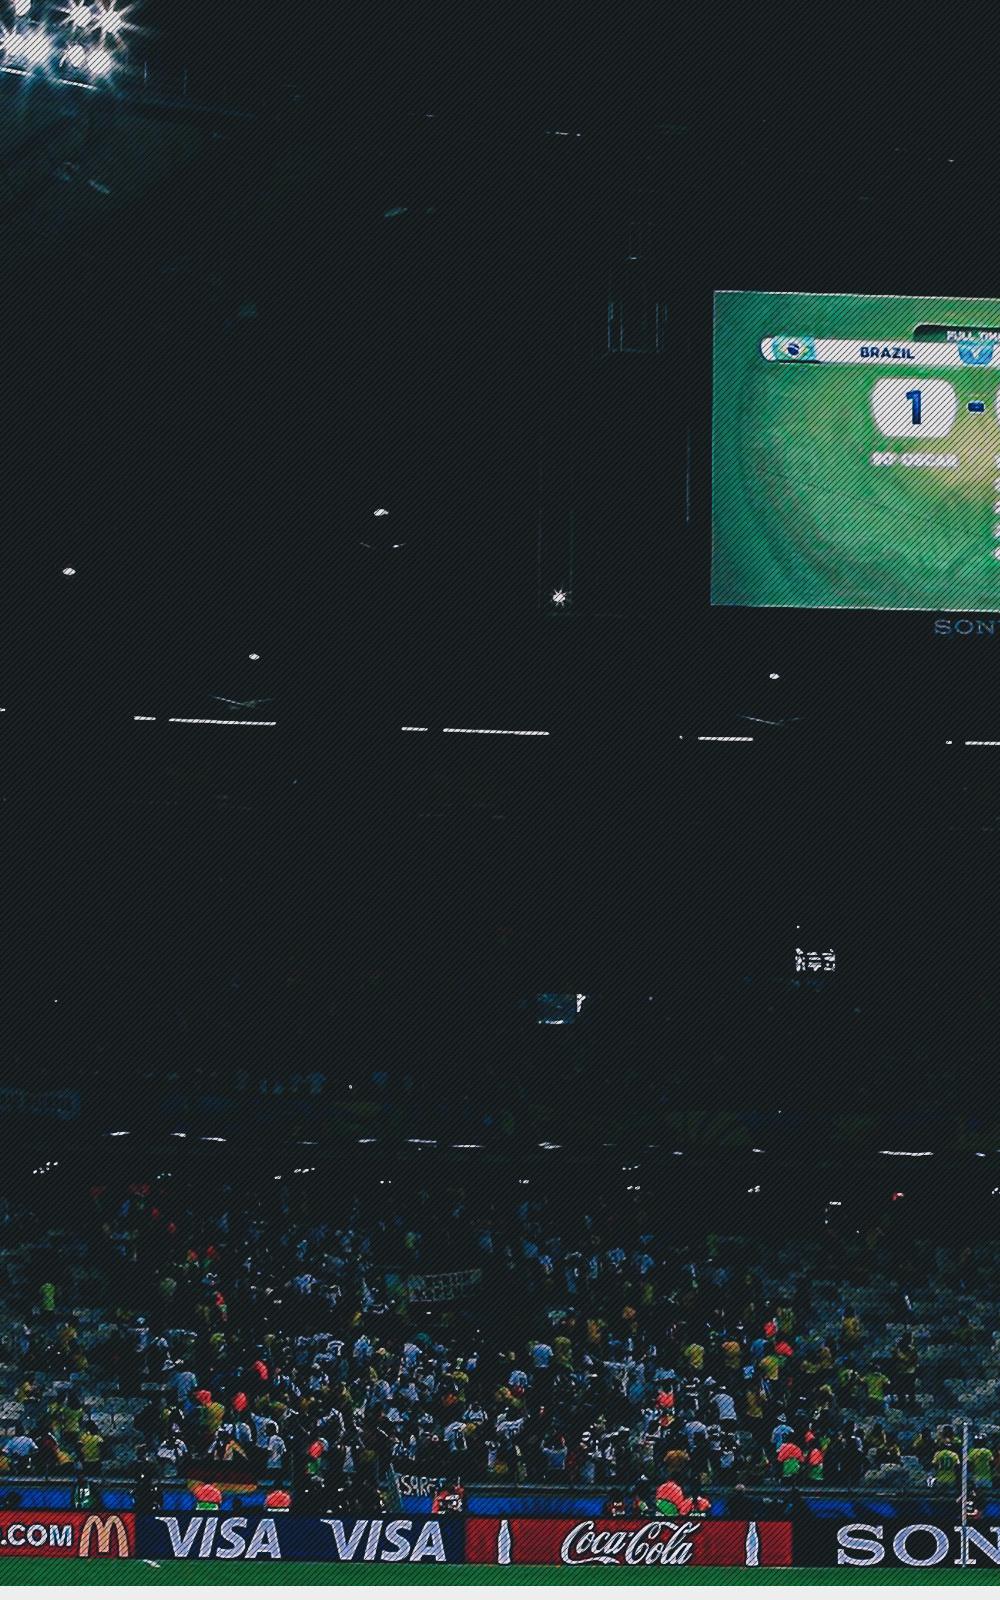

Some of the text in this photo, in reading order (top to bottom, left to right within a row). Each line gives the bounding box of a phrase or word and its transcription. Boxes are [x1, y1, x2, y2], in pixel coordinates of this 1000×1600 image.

[946, 330, 974, 342] FULL
[860, 346, 916, 360] BRAZIL
[905, 390, 922, 425] 1
[901, 453, 959, 468] OSCAR
[0, 1523, 73, 1548] .COM
[154, 1516, 282, 1559] VISA
[320, 1519, 447, 1562] VISA
[561, 1520, 701, 1566] Coca-Cola
